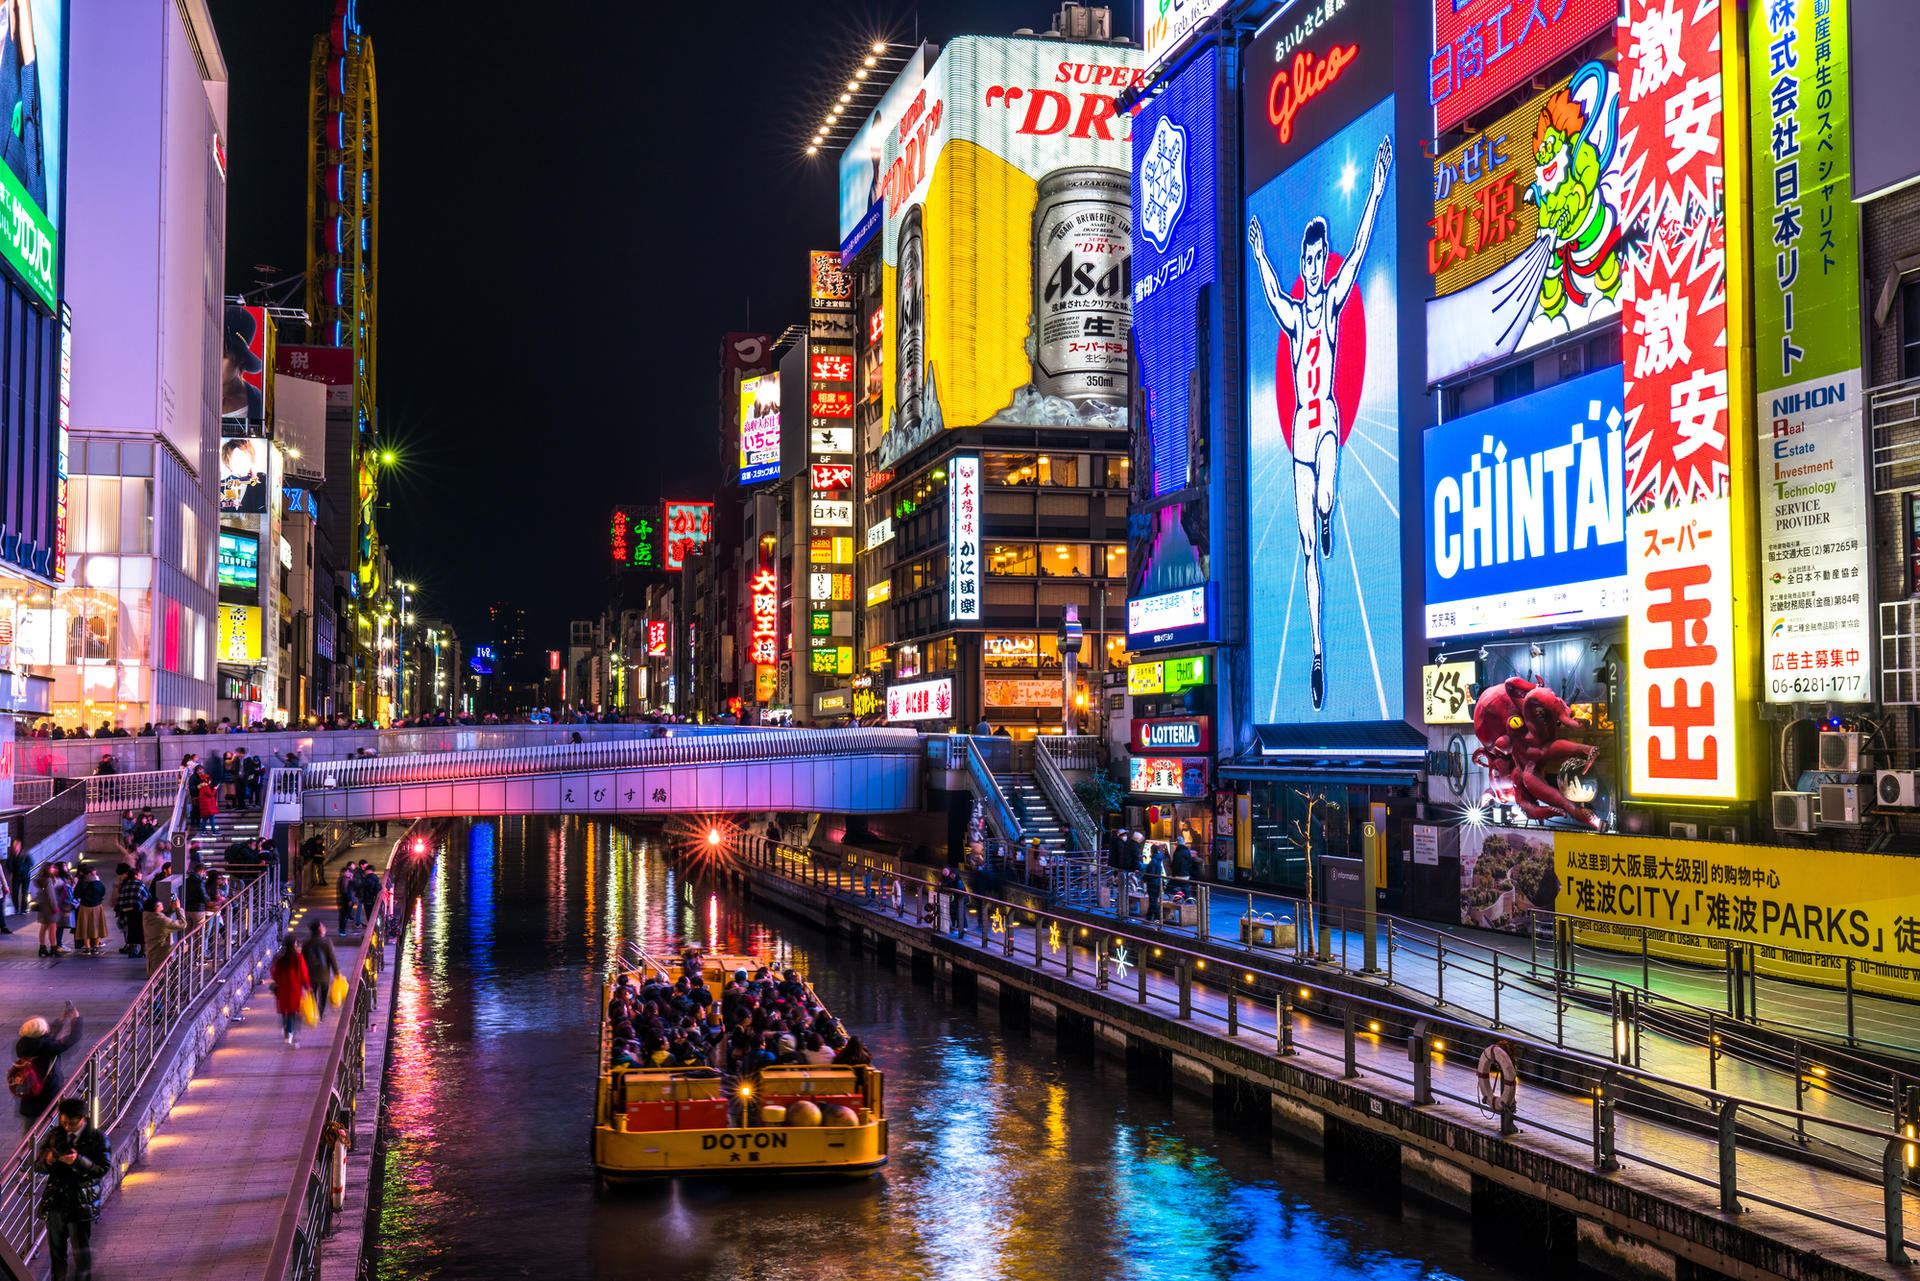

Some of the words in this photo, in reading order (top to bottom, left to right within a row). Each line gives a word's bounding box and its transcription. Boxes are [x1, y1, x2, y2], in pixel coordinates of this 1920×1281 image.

[1055, 62, 1146, 88] SUPER
[1628, 2, 1721, 174] 激安
[1269, 44, 1359, 144] Glico
[899, 88, 926, 144] SUPER
[1434, 134, 1508, 200] かぜに
[1769, 0, 1804, 376] 株式会社日本リート
[1056, 221, 1075, 240] ASAHI
[1076, 212, 1116, 225] BREWERIES
[1426, 170, 1517, 276] 改源
[1134, 247, 1194, 304] 雪印メグミルク
[814, 299, 825, 307] 9F
[1083, 316, 1115, 337] 生
[1085, 354, 1112, 363] 生ビール
[1086, 376, 1113, 387] 350ml
[1306, 329, 1321, 430] グリコ
[1632, 283, 1729, 461] 激安
[812, 403, 852, 416] ダイニング
[1772, 382, 1846, 418] NIHON
[743, 414, 780, 433] 高収入お仕
[1773, 418, 1805, 438] Real
[1774, 439, 1815, 460] Estate
[1774, 459, 1834, 480] Investment
[1434, 401, 1624, 579] CHINTAI
[1773, 479, 1837, 501] Technology
[814, 504, 849, 519] 白木屋
[960, 482, 974, 535] 本場の味
[1775, 499, 1820, 517] SERVICE
[1775, 515, 1831, 532] PROVIDER
[1644, 519, 1712, 558] スーパー
[959, 541, 976, 614] かに道楽
[1787, 566, 1859, 585] 全日本不動産協会
[752, 568, 777, 664] 大阪王将
[1644, 564, 1717, 780] 玉出
[1772, 647, 1860, 671] 広告主募集中
[1772, 675, 1861, 694] 06-6281-1717
[1151, 723, 1196, 746] LOTTERIA
[565, 788, 667, 802] えびす橋
[1567, 851, 1780, 889] 从这里到大阪最大级别的购物中心
[1612, 924, 1642, 942] shopping
[1760, 944, 1776, 960] and
[1782, 948, 1812, 965] Namba
[1814, 951, 1841, 969] Parks
[702, 1133, 787, 1150] DOTON
